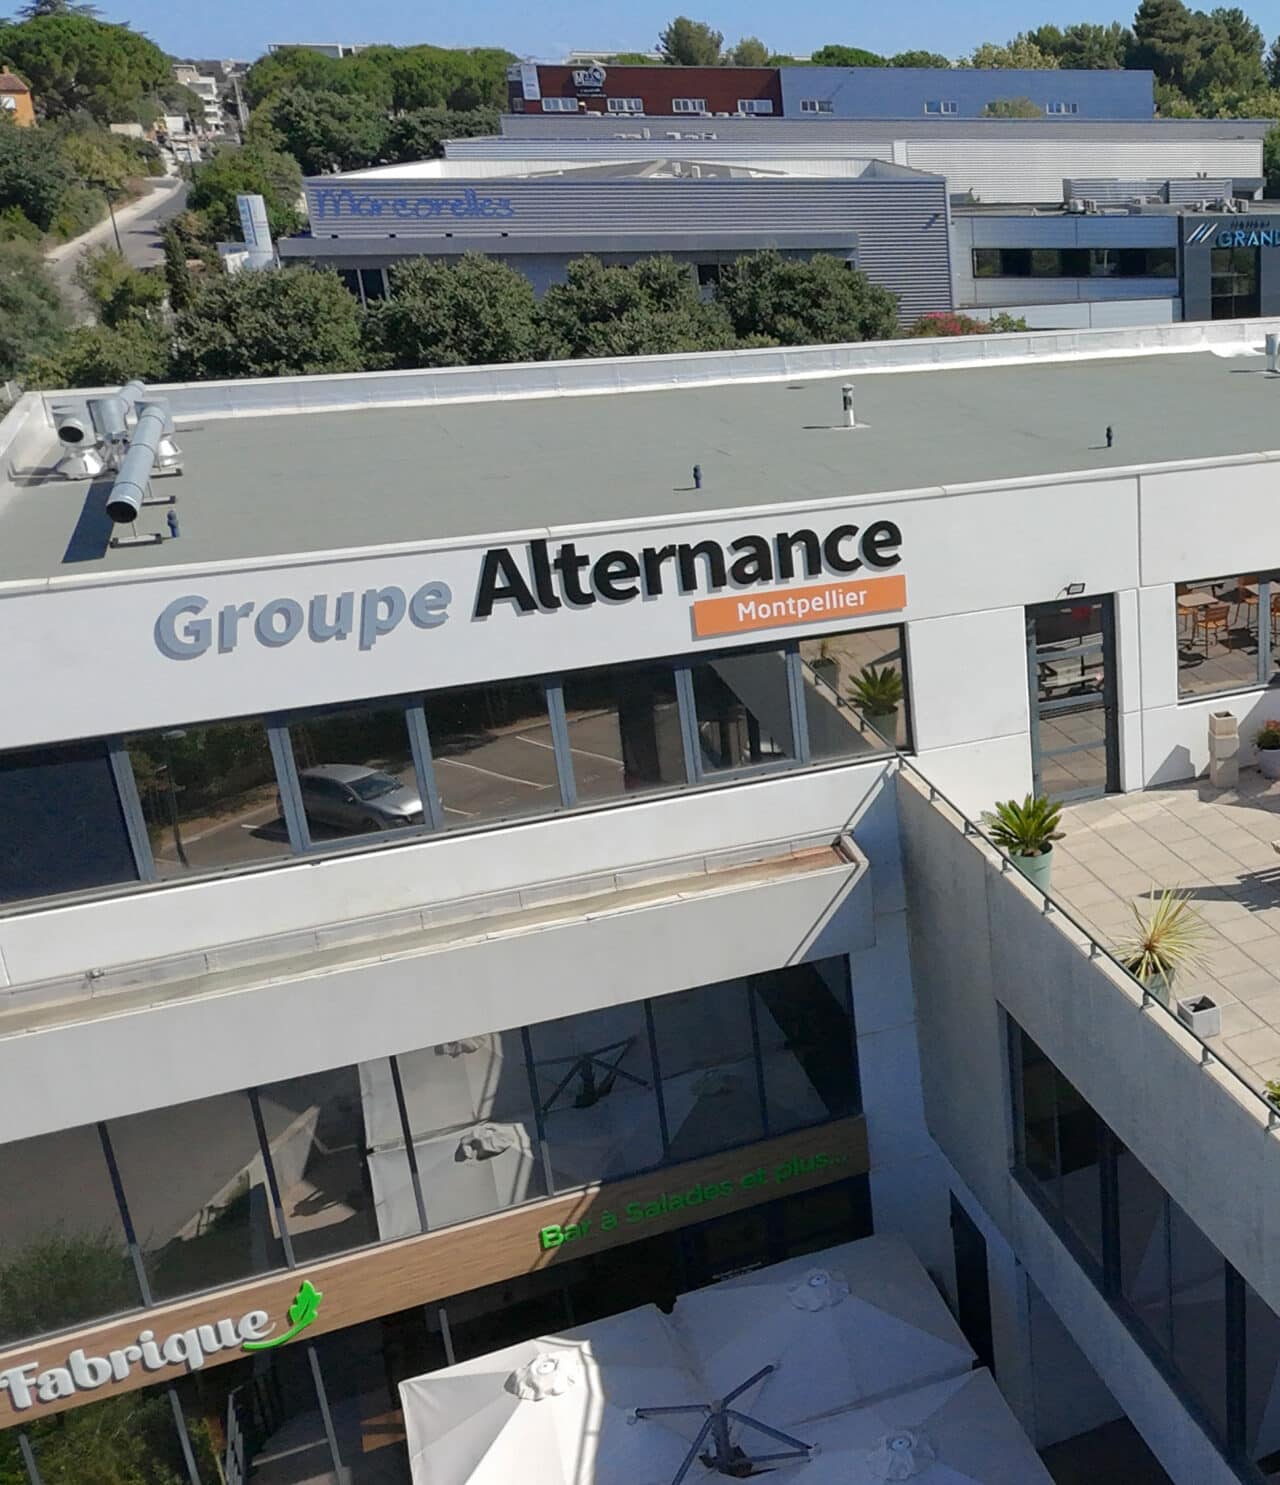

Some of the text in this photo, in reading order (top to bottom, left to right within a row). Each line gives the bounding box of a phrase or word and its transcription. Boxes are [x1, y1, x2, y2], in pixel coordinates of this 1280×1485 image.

[153, 518, 902, 661] Groupe Alternance
[737, 588, 867, 622] Montpellier
[541, 1219, 592, 1250] Bar
[601, 1210, 618, 1231] à
[625, 1179, 733, 1224] Salades
[741, 1165, 768, 1190] et
[0, 1309, 276, 1409] Fabrique
